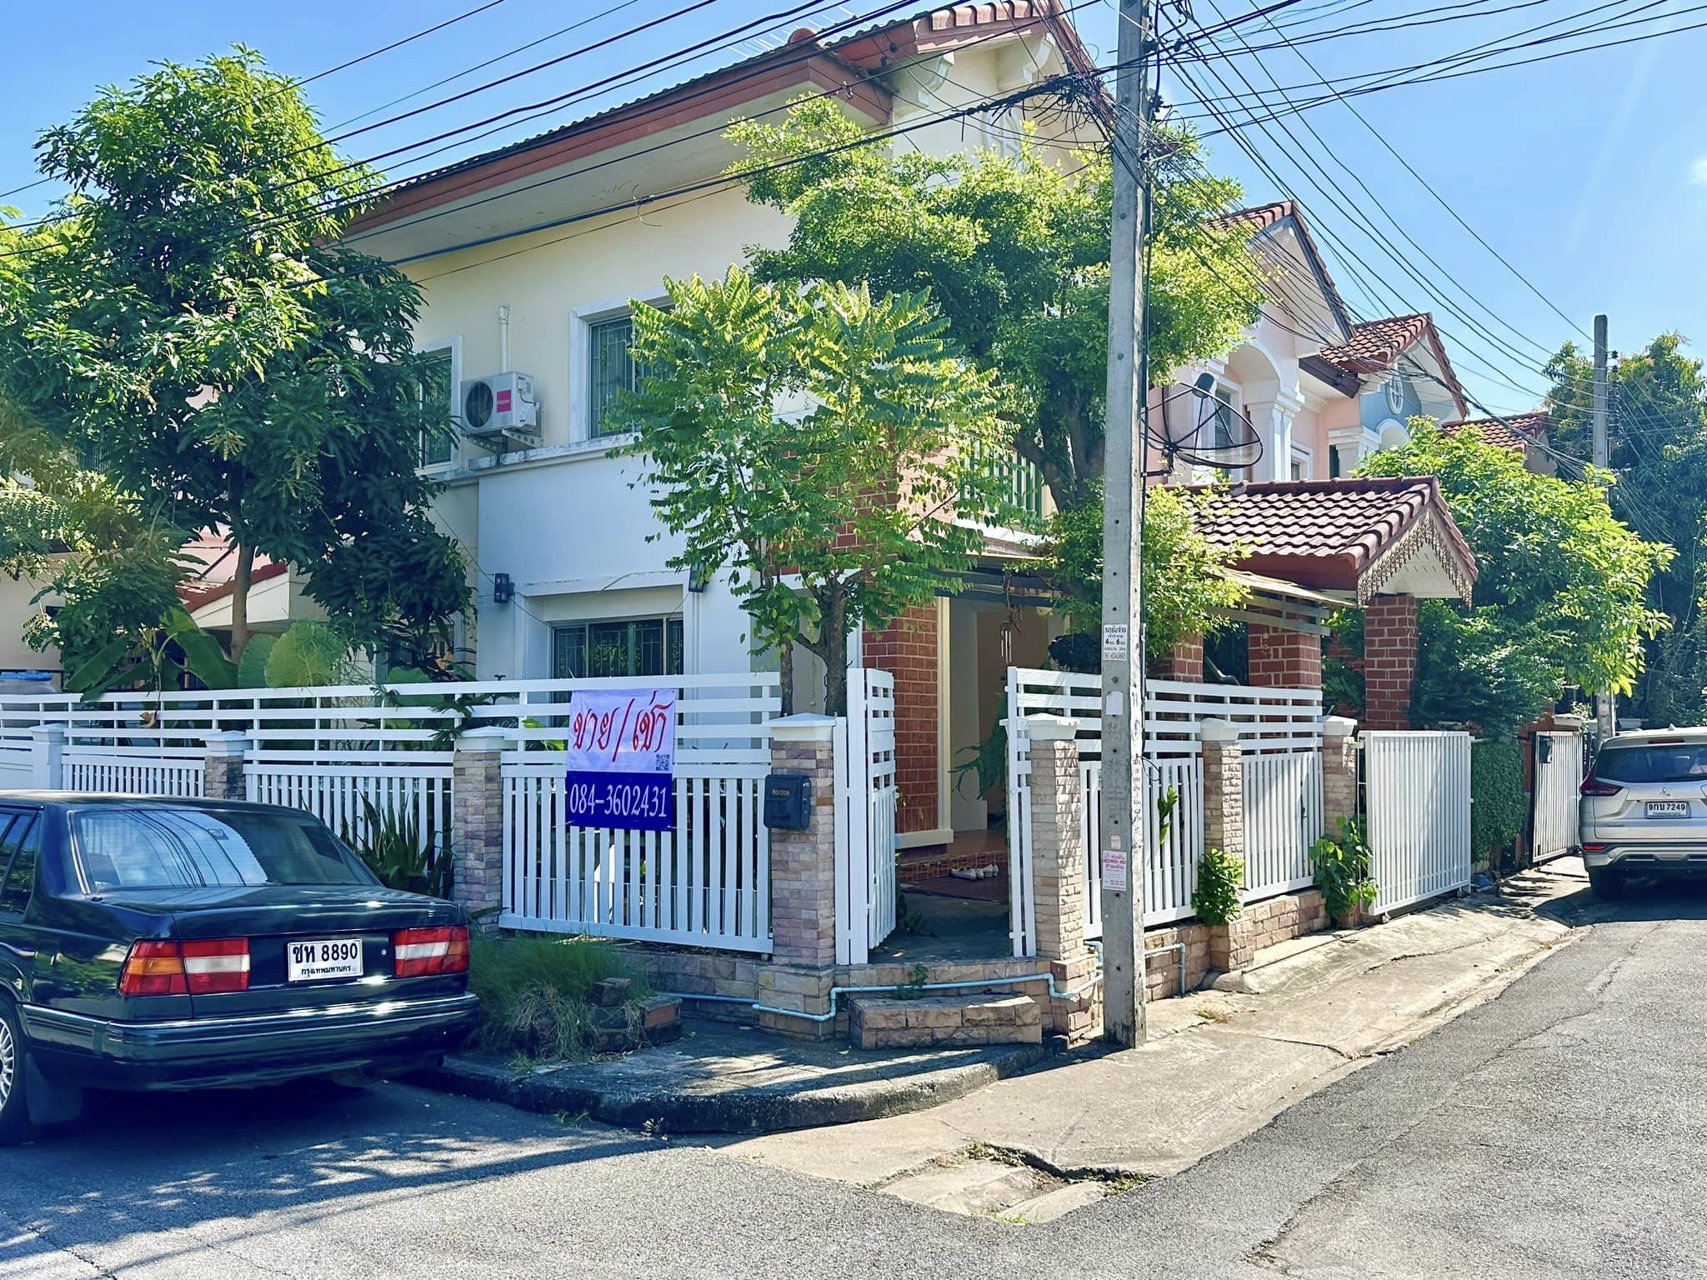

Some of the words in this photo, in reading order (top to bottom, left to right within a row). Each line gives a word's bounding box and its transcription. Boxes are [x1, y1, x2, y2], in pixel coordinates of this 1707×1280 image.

[570, 783, 667, 818] 084-3602431
[1666, 803, 1686, 811] 7249
[321, 943, 358, 962] 8890
